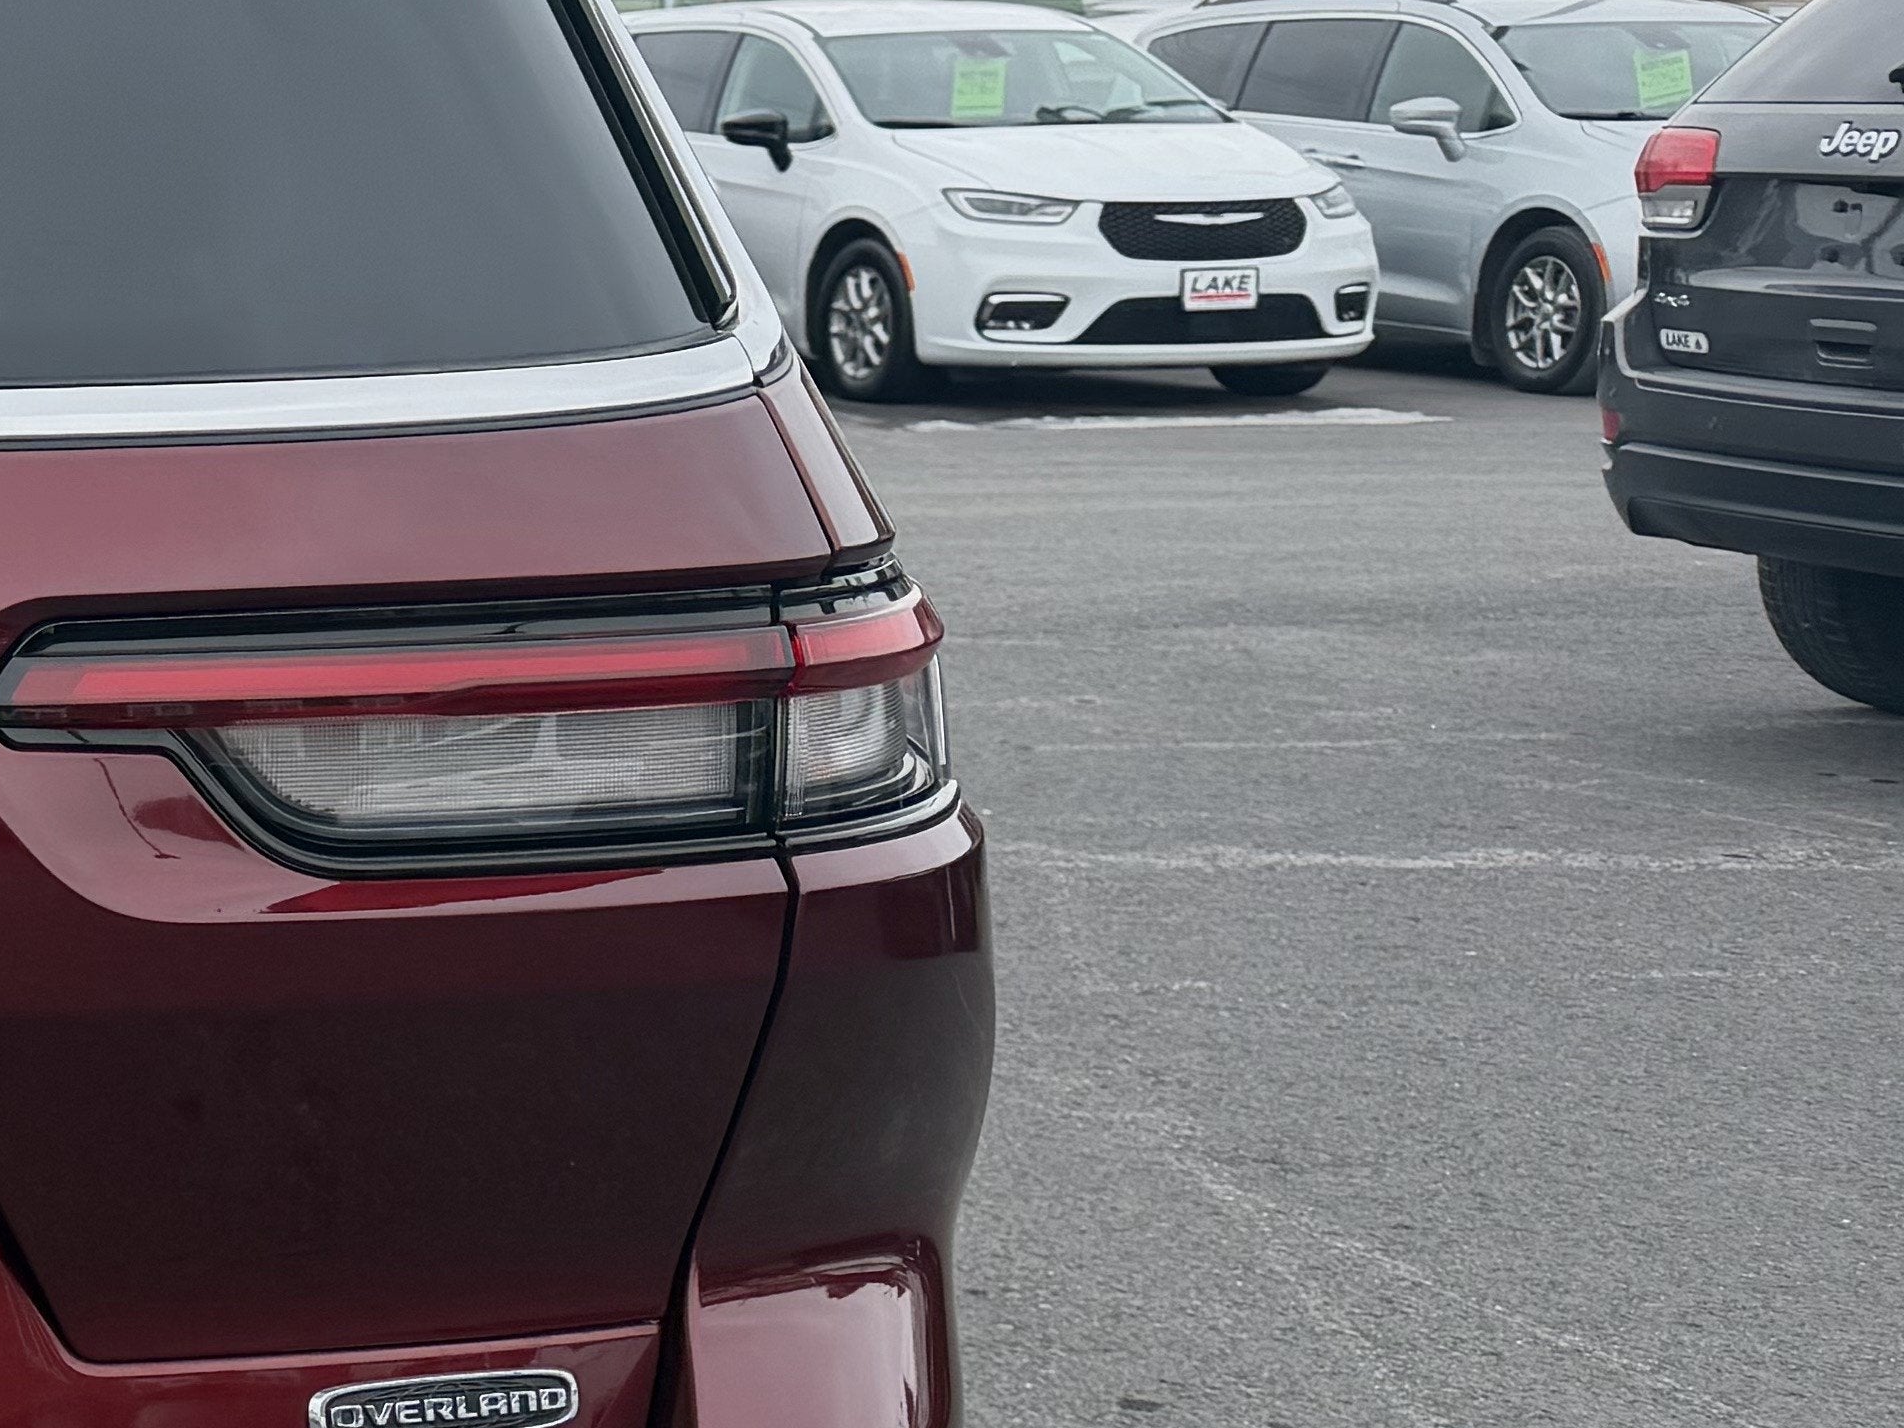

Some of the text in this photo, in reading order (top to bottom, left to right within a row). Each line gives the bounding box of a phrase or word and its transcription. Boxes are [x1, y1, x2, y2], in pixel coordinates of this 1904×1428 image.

[1819, 122, 1900, 162] Jeep
[1192, 274, 1251, 293] LAKE
[1665, 332, 1690, 348] LAKE
[330, 1387, 567, 1428] OVERLAND
